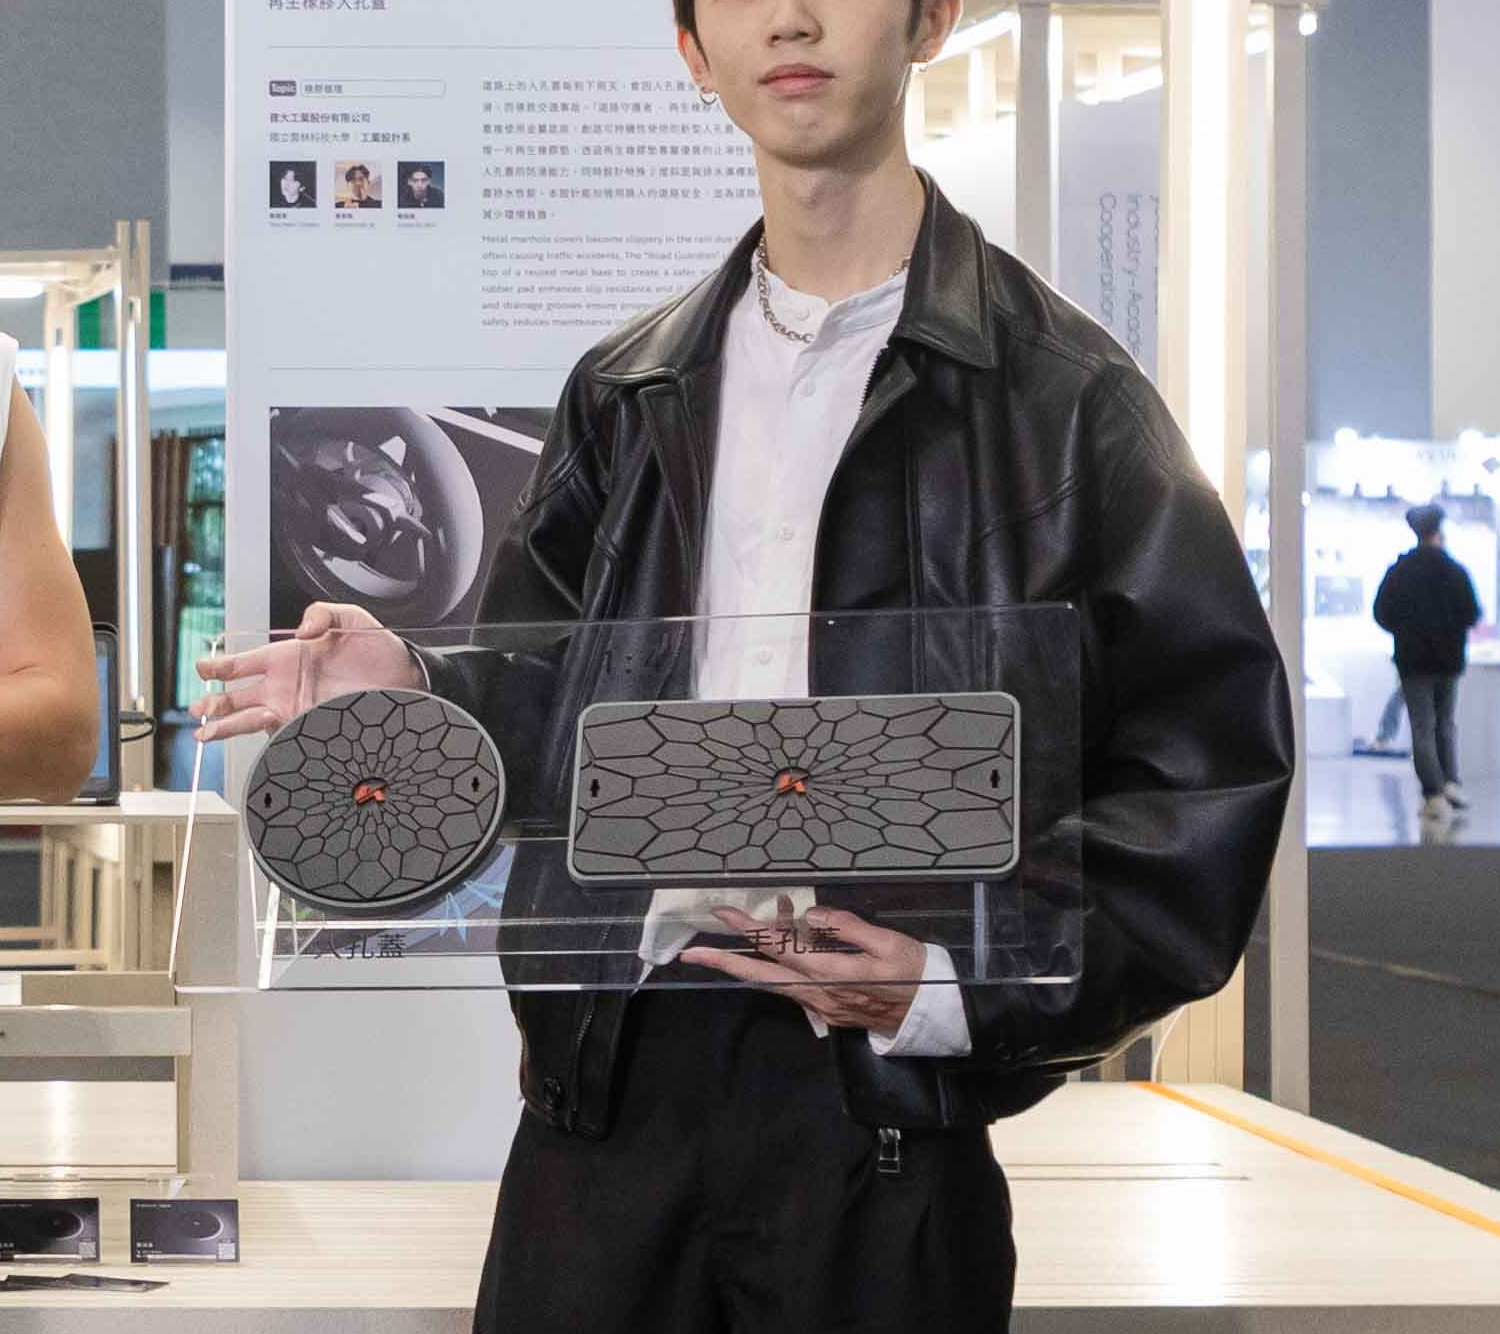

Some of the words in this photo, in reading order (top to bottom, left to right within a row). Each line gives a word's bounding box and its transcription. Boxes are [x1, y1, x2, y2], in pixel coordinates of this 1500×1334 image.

[314, 933, 406, 959] 人孔蓋
[744, 926, 841, 955] 手孔蓋
